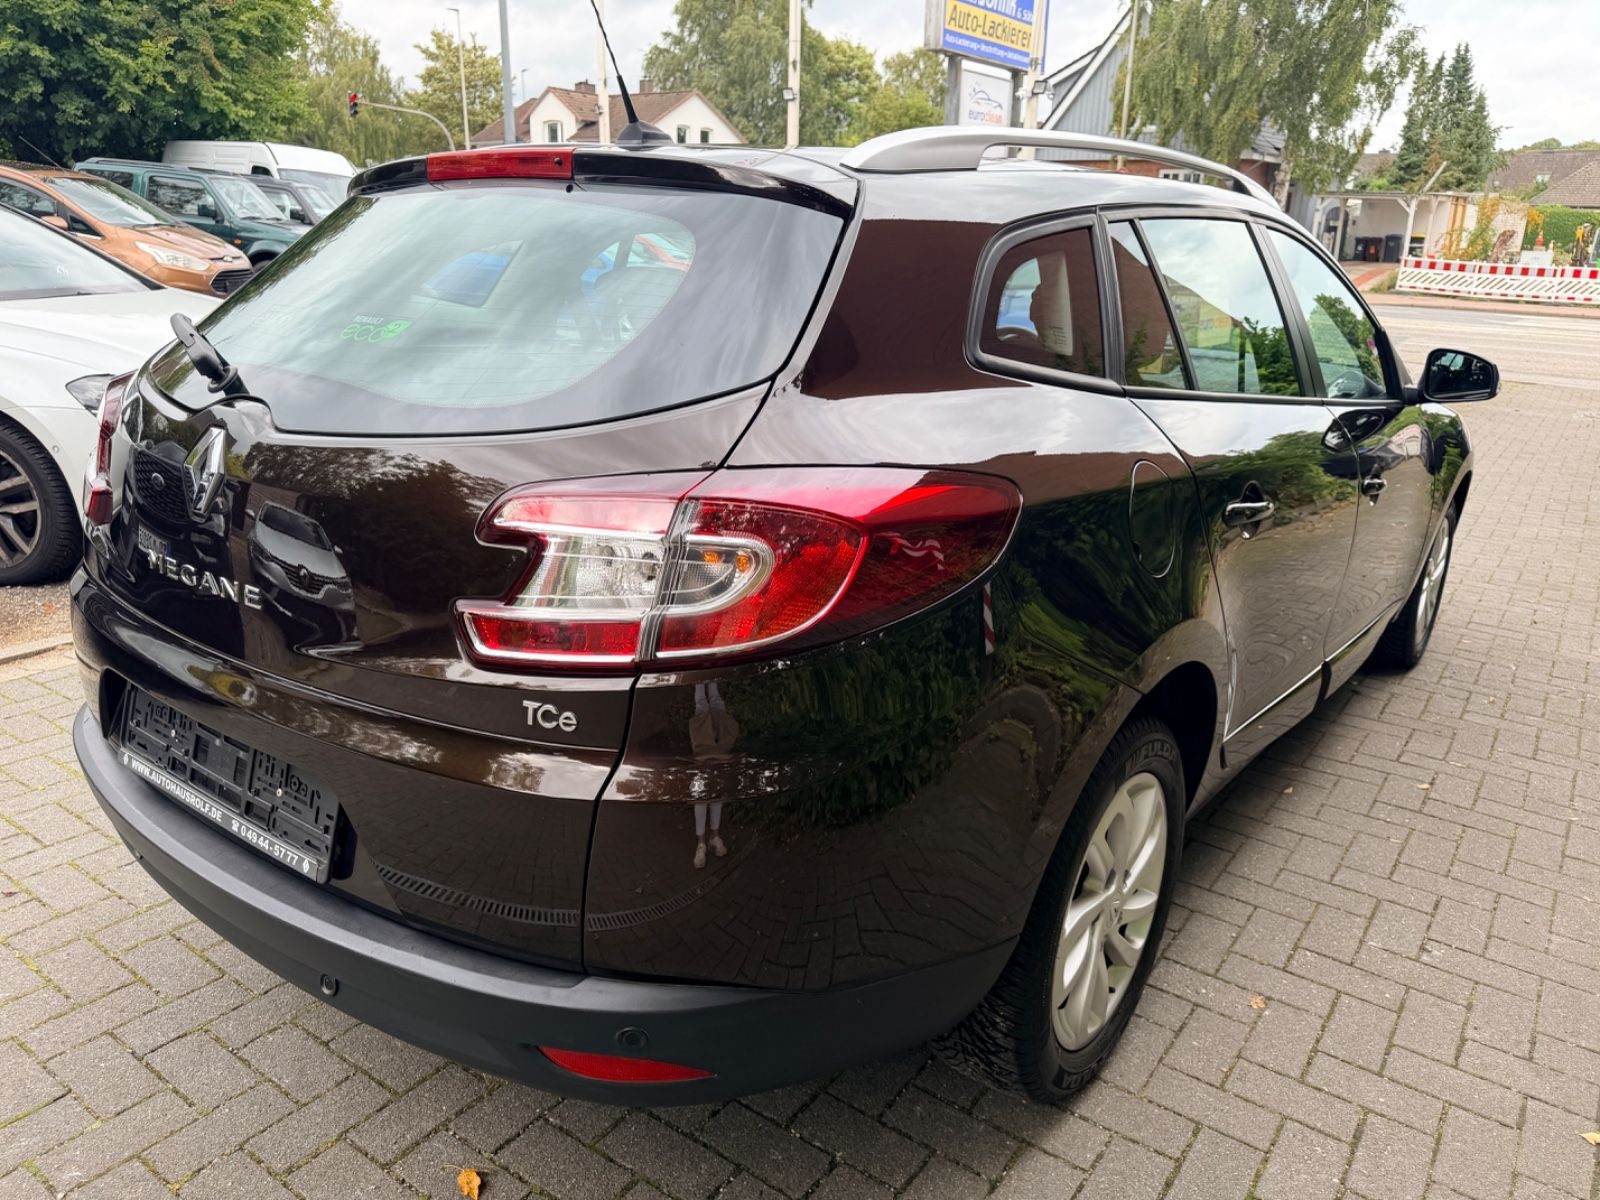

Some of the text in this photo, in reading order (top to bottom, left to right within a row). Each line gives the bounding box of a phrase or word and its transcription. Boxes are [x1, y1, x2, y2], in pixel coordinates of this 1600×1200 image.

[147, 549, 262, 611] MEGANE
[522, 699, 578, 733] TCe
[131, 758, 223, 822] WWW.AUTOHAUSROLF.DE
